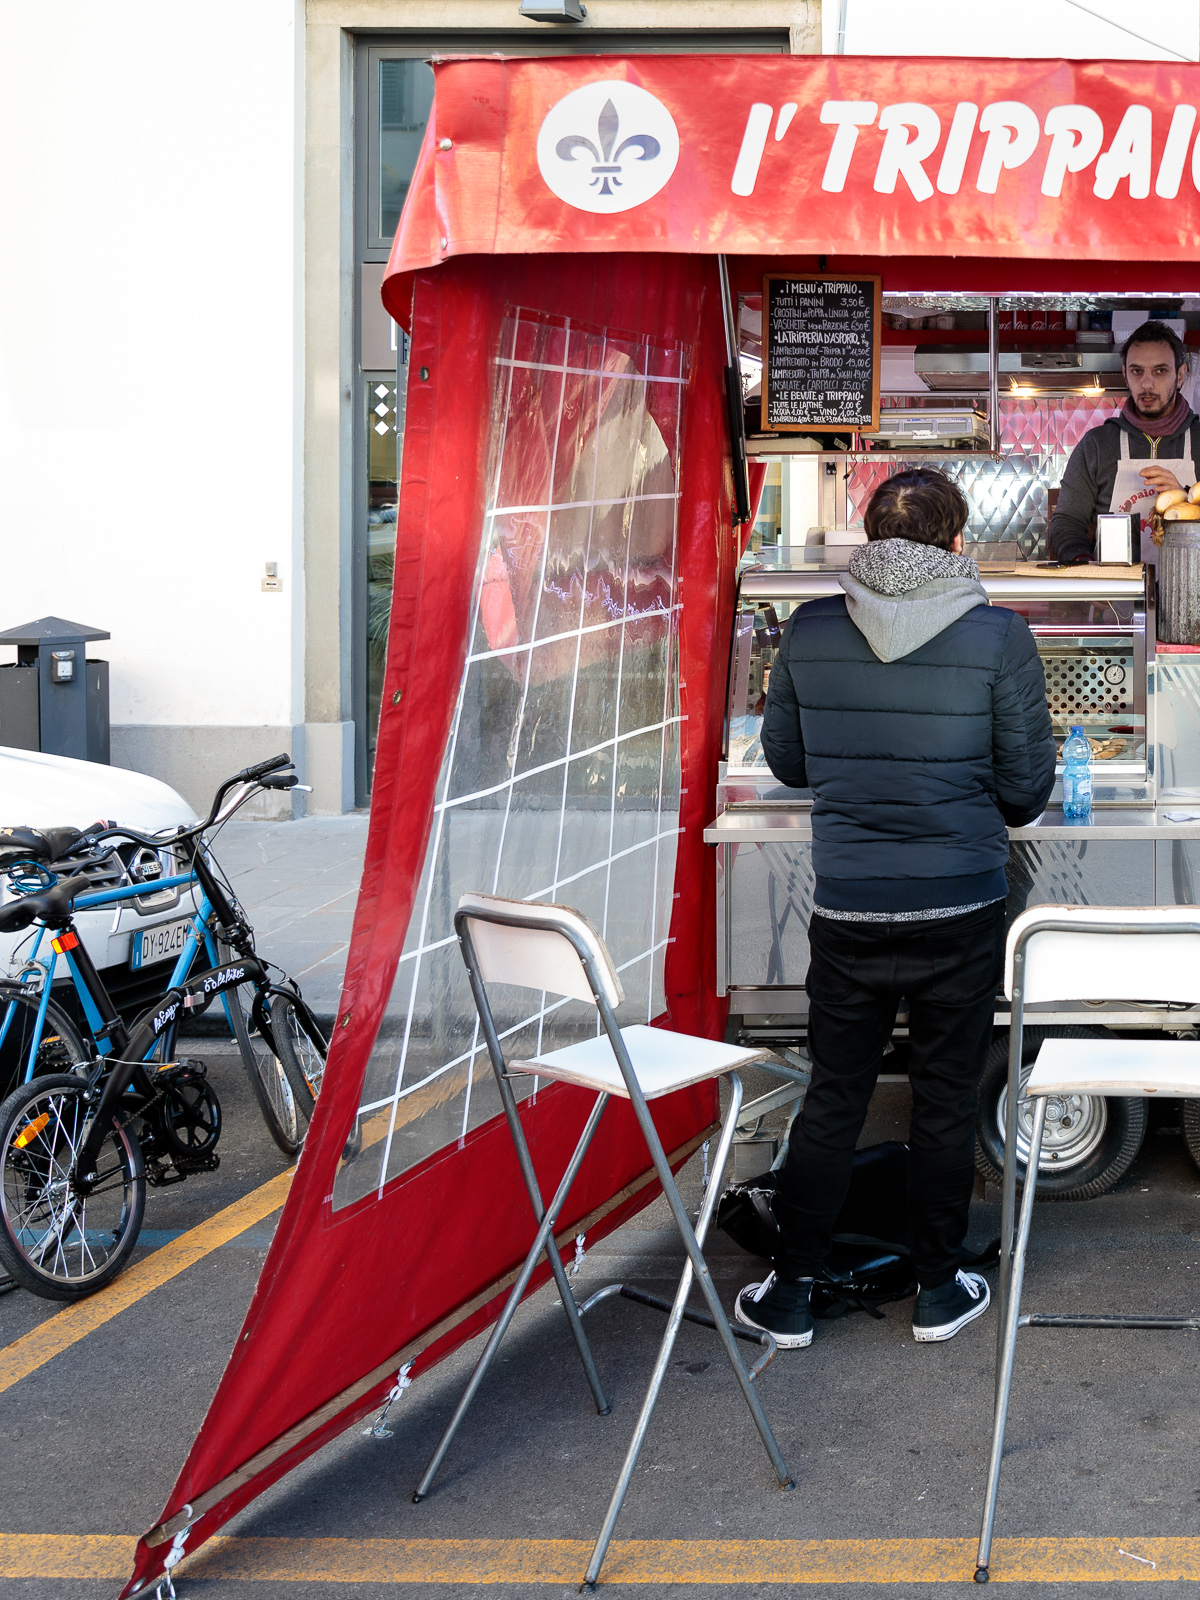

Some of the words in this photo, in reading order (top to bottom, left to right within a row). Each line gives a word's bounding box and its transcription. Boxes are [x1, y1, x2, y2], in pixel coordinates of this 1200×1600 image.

[780, 391, 789, 400] LE
[791, 391, 817, 400] BEVUTE
[825, 391, 861, 401] TRIPPAIO
